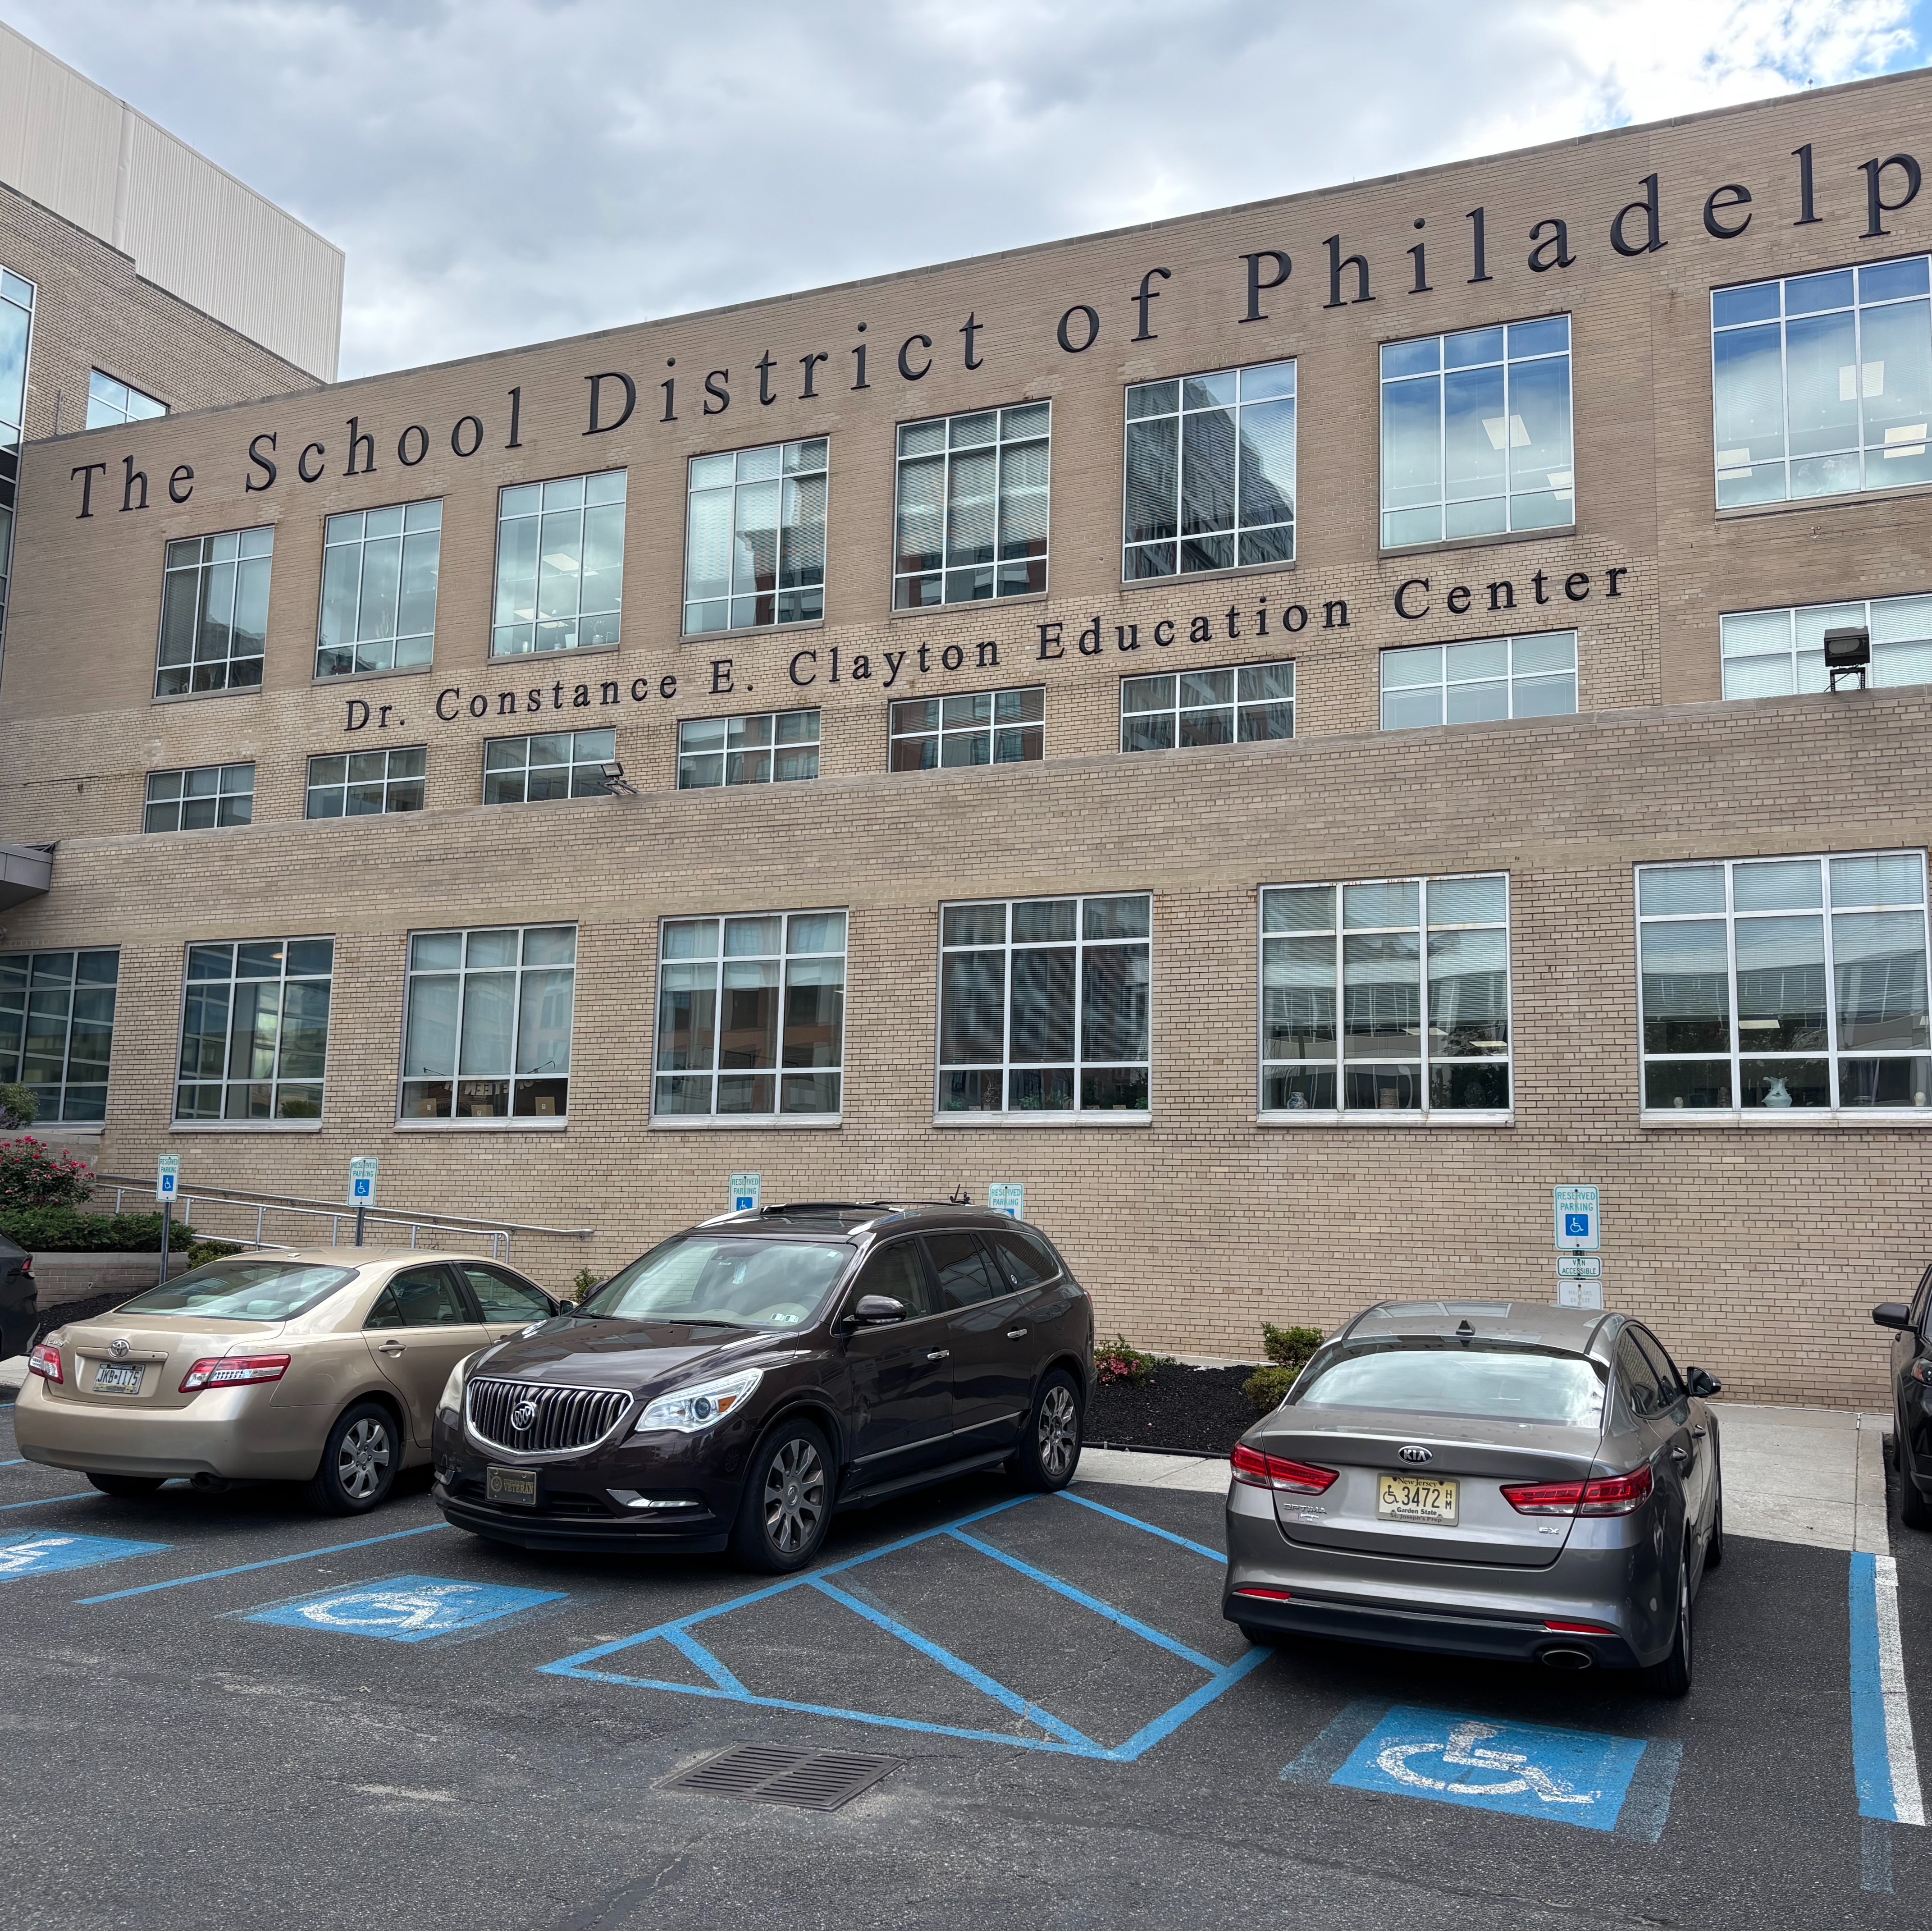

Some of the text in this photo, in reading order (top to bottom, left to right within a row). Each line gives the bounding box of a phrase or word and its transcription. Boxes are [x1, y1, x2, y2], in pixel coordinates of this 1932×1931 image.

[70, 143, 1922, 519] The School District of Philadelp
[343, 567, 1628, 731] Dr. Constance E. Clayton Education Center
[1557, 1192, 1595, 1200] RESERVED
[1403, 1449, 1426, 1460] KIA
[504, 1483, 534, 1495] VETERAN
[1415, 1479, 1438, 1488] Jersey
[1402, 1486, 1440, 1509] 3472
[1283, 1503, 1327, 1514] OPTIMA
